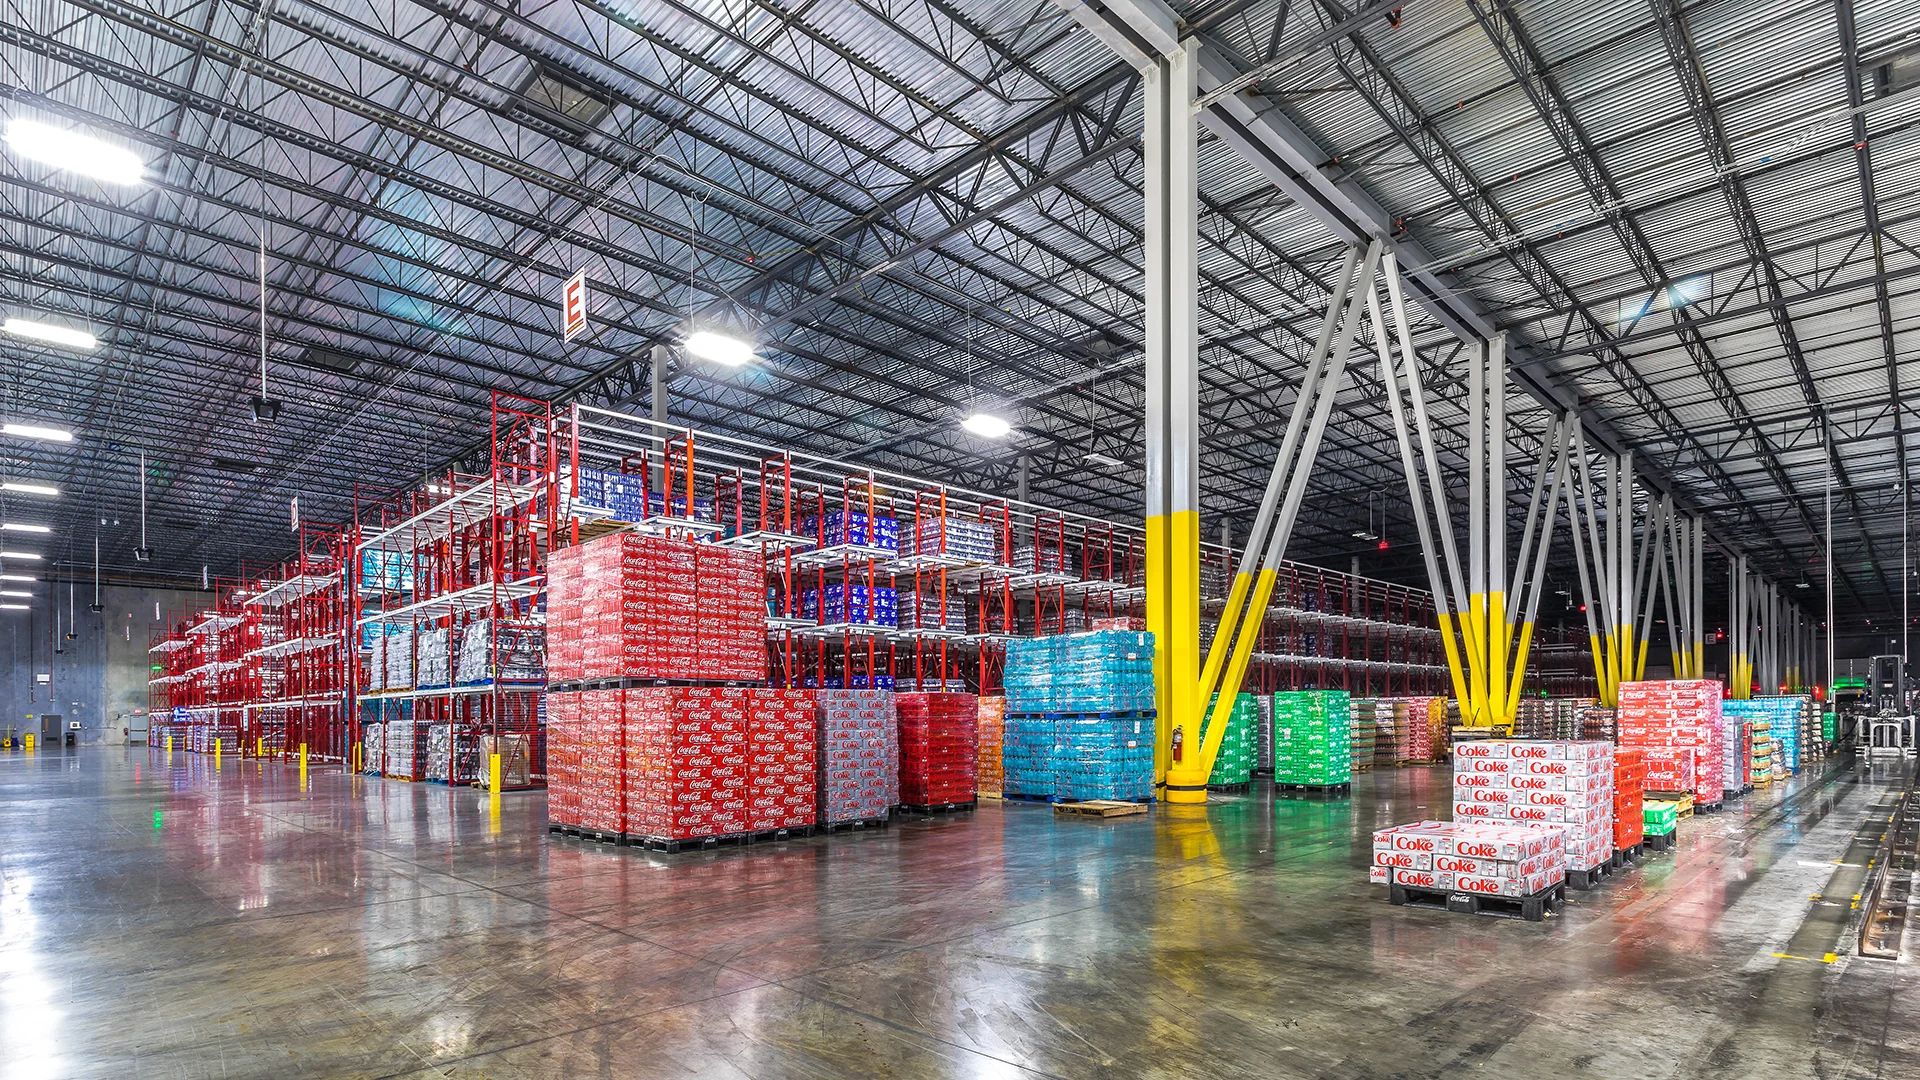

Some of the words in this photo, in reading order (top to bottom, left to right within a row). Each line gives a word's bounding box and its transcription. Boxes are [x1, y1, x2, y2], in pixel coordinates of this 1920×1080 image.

[567, 280, 580, 325] E
[689, 688, 711, 697] Coca-Cola
[722, 688, 742, 697] Coca-Cola
[754, 690, 775, 698] Coca-Cola
[784, 690, 804, 698] Coca-Cola
[676, 700, 700, 708] Coca-Cola
[710, 700, 732, 708] Coca-Cola
[764, 700, 784, 709] Coca-Cola
[794, 700, 812, 708] Coca-Cola
[688, 710, 711, 720] Coca-Cola
[722, 710, 742, 720] Coca-Cola
[754, 710, 775, 720] Coca-Cola
[784, 710, 804, 720] Coca-Cola
[677, 722, 700, 732] Coca-Cola
[711, 722, 732, 730] Coca-Cola
[764, 722, 784, 730] Coca-Cola
[794, 721, 812, 730] Coca-Cola
[689, 733, 712, 742] Coca-Cola
[722, 732, 743, 742] Coca-Cola
[754, 732, 775, 741] Coca-Cola
[784, 732, 804, 740] Coca-Cola
[677, 744, 700, 755] Coca-Cola
[711, 744, 733, 753] Coca-Cola
[764, 742, 784, 752] Coca-Cola
[794, 742, 812, 751] Coca-Cola
[1456, 744, 1490, 758] Coke
[784, 752, 804, 762] Coca-Cola
[1511, 746, 1548, 759] Coke
[690, 756, 712, 766] Coca-Cola
[722, 754, 744, 764] Coca-Cola
[754, 754, 775, 763] Coca-Cola
[712, 766, 734, 776] Coca-Cola
[764, 764, 784, 774] Coca-Cola
[793, 762, 812, 772] Coca-Cola
[1474, 760, 1508, 773] Coke
[1530, 762, 1567, 774] Coke
[678, 768, 700, 778] Coca-Cola
[722, 778, 744, 787] Coca-Cola
[754, 776, 775, 785] Coca-Cola
[784, 774, 804, 783] Coca-Cola
[1456, 774, 1490, 787] Coke
[1510, 776, 1547, 790] Coke
[690, 780, 712, 790] Coca-Cola
[793, 784, 812, 793] Coca-Cola
[712, 790, 734, 799] Coca-Cola
[764, 786, 784, 796] Coca-Cola
[1474, 790, 1508, 802] Coke
[678, 791, 701, 802] Coca-Cola
[784, 795, 804, 804] Coca-Cola
[1530, 792, 1567, 806] Coke
[690, 802, 712, 812] Coca-Cola
[722, 800, 744, 810] Coca-Cola
[754, 797, 774, 807] Coca-Cola
[764, 807, 784, 817] Coca-Cola
[793, 804, 812, 814] Coca-Cola
[1456, 804, 1489, 816] Coke
[1510, 806, 1546, 820] Coke
[678, 814, 702, 824] Coca-Cola
[712, 812, 734, 822] Coca-Cola
[784, 816, 804, 826] Coca-Cola
[722, 822, 744, 832] Coca-Cola
[754, 818, 774, 828] Coca-Cola
[690, 825, 712, 836] Coca-Cola
[1373, 834, 1390, 844] Coke
[1396, 836, 1434, 852] Coke
[1457, 842, 1498, 858] Coke
[1376, 852, 1412, 868] Coke
[1437, 858, 1477, 874] Coke
[1370, 868, 1388, 878] Coke
[1397, 871, 1435, 886] Coke
[1458, 878, 1500, 894] Coke
